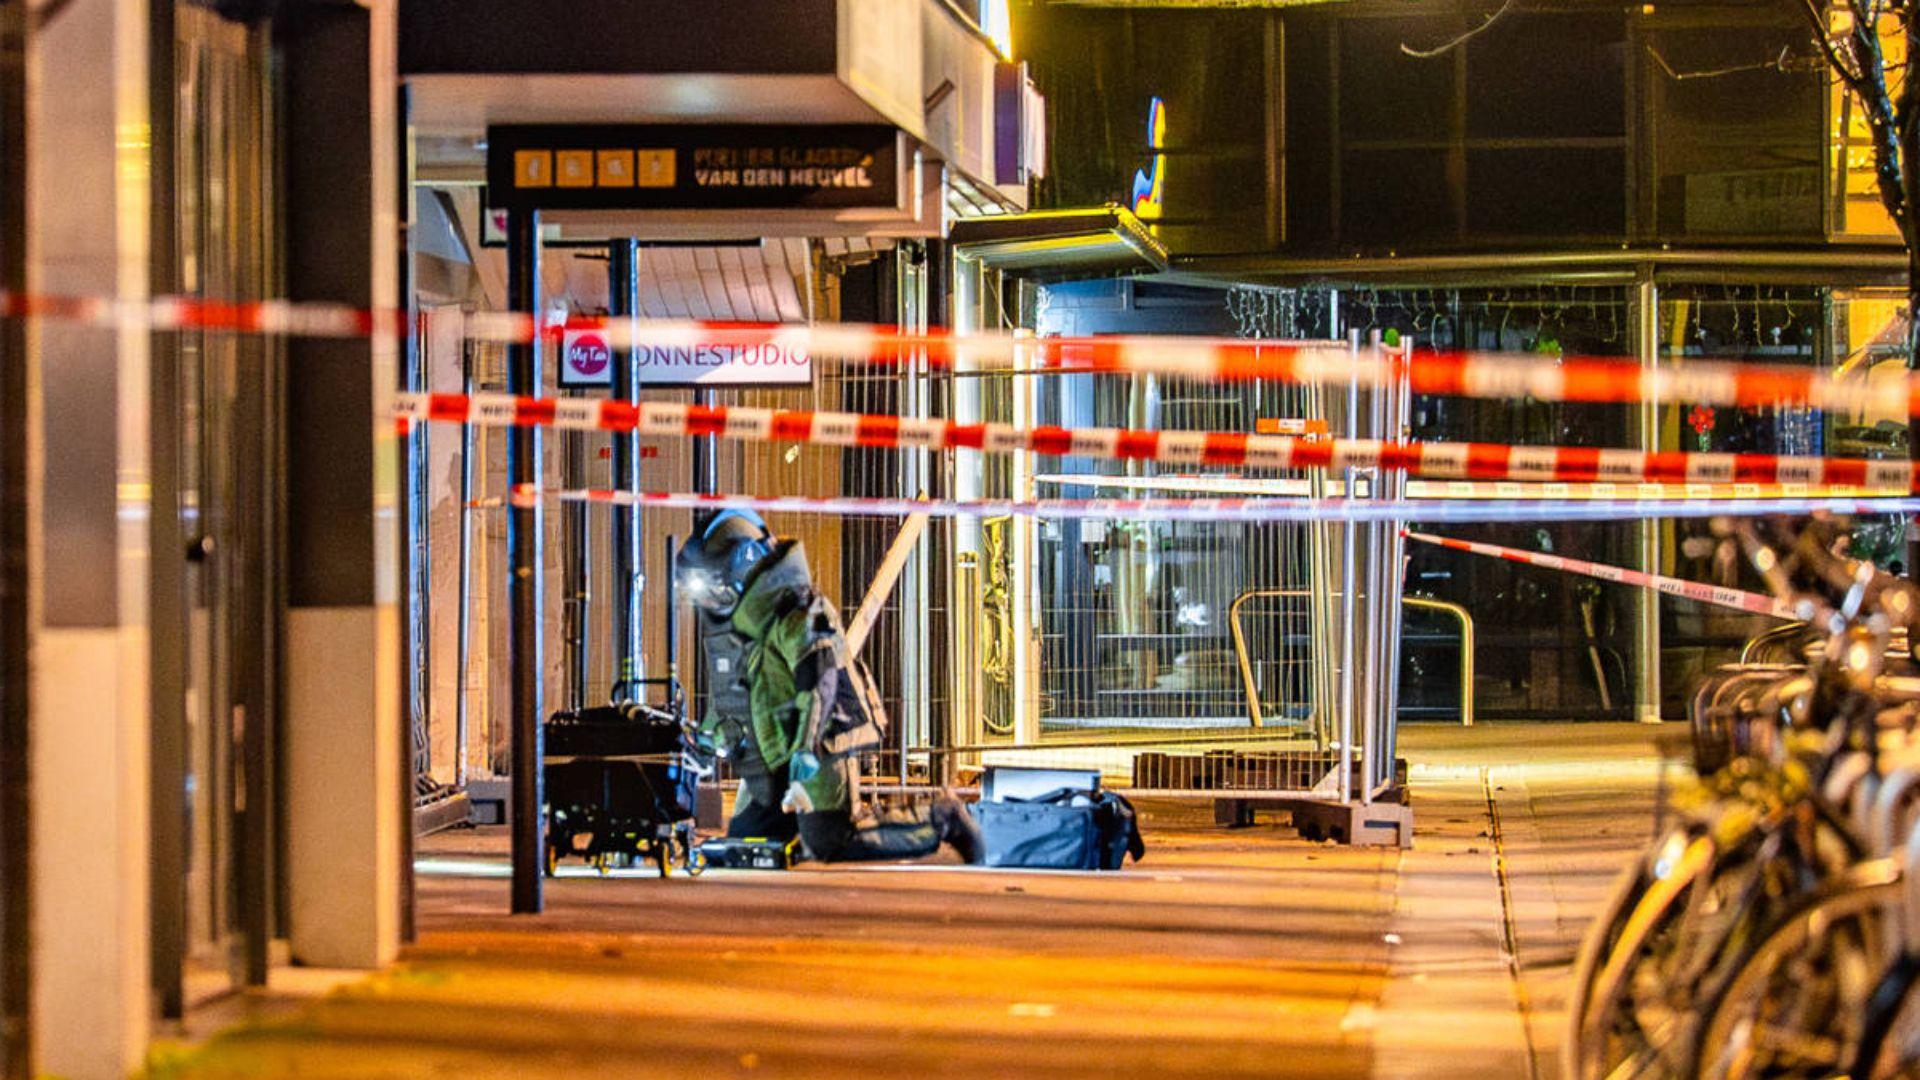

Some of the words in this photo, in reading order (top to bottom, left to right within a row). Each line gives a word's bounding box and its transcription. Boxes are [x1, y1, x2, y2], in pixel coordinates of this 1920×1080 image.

[695, 168, 738, 186] VAN
[743, 168, 785, 186] DEN
[789, 167, 873, 187] HEUVEL
[637, 343, 810, 366] ONNESTUDIO
